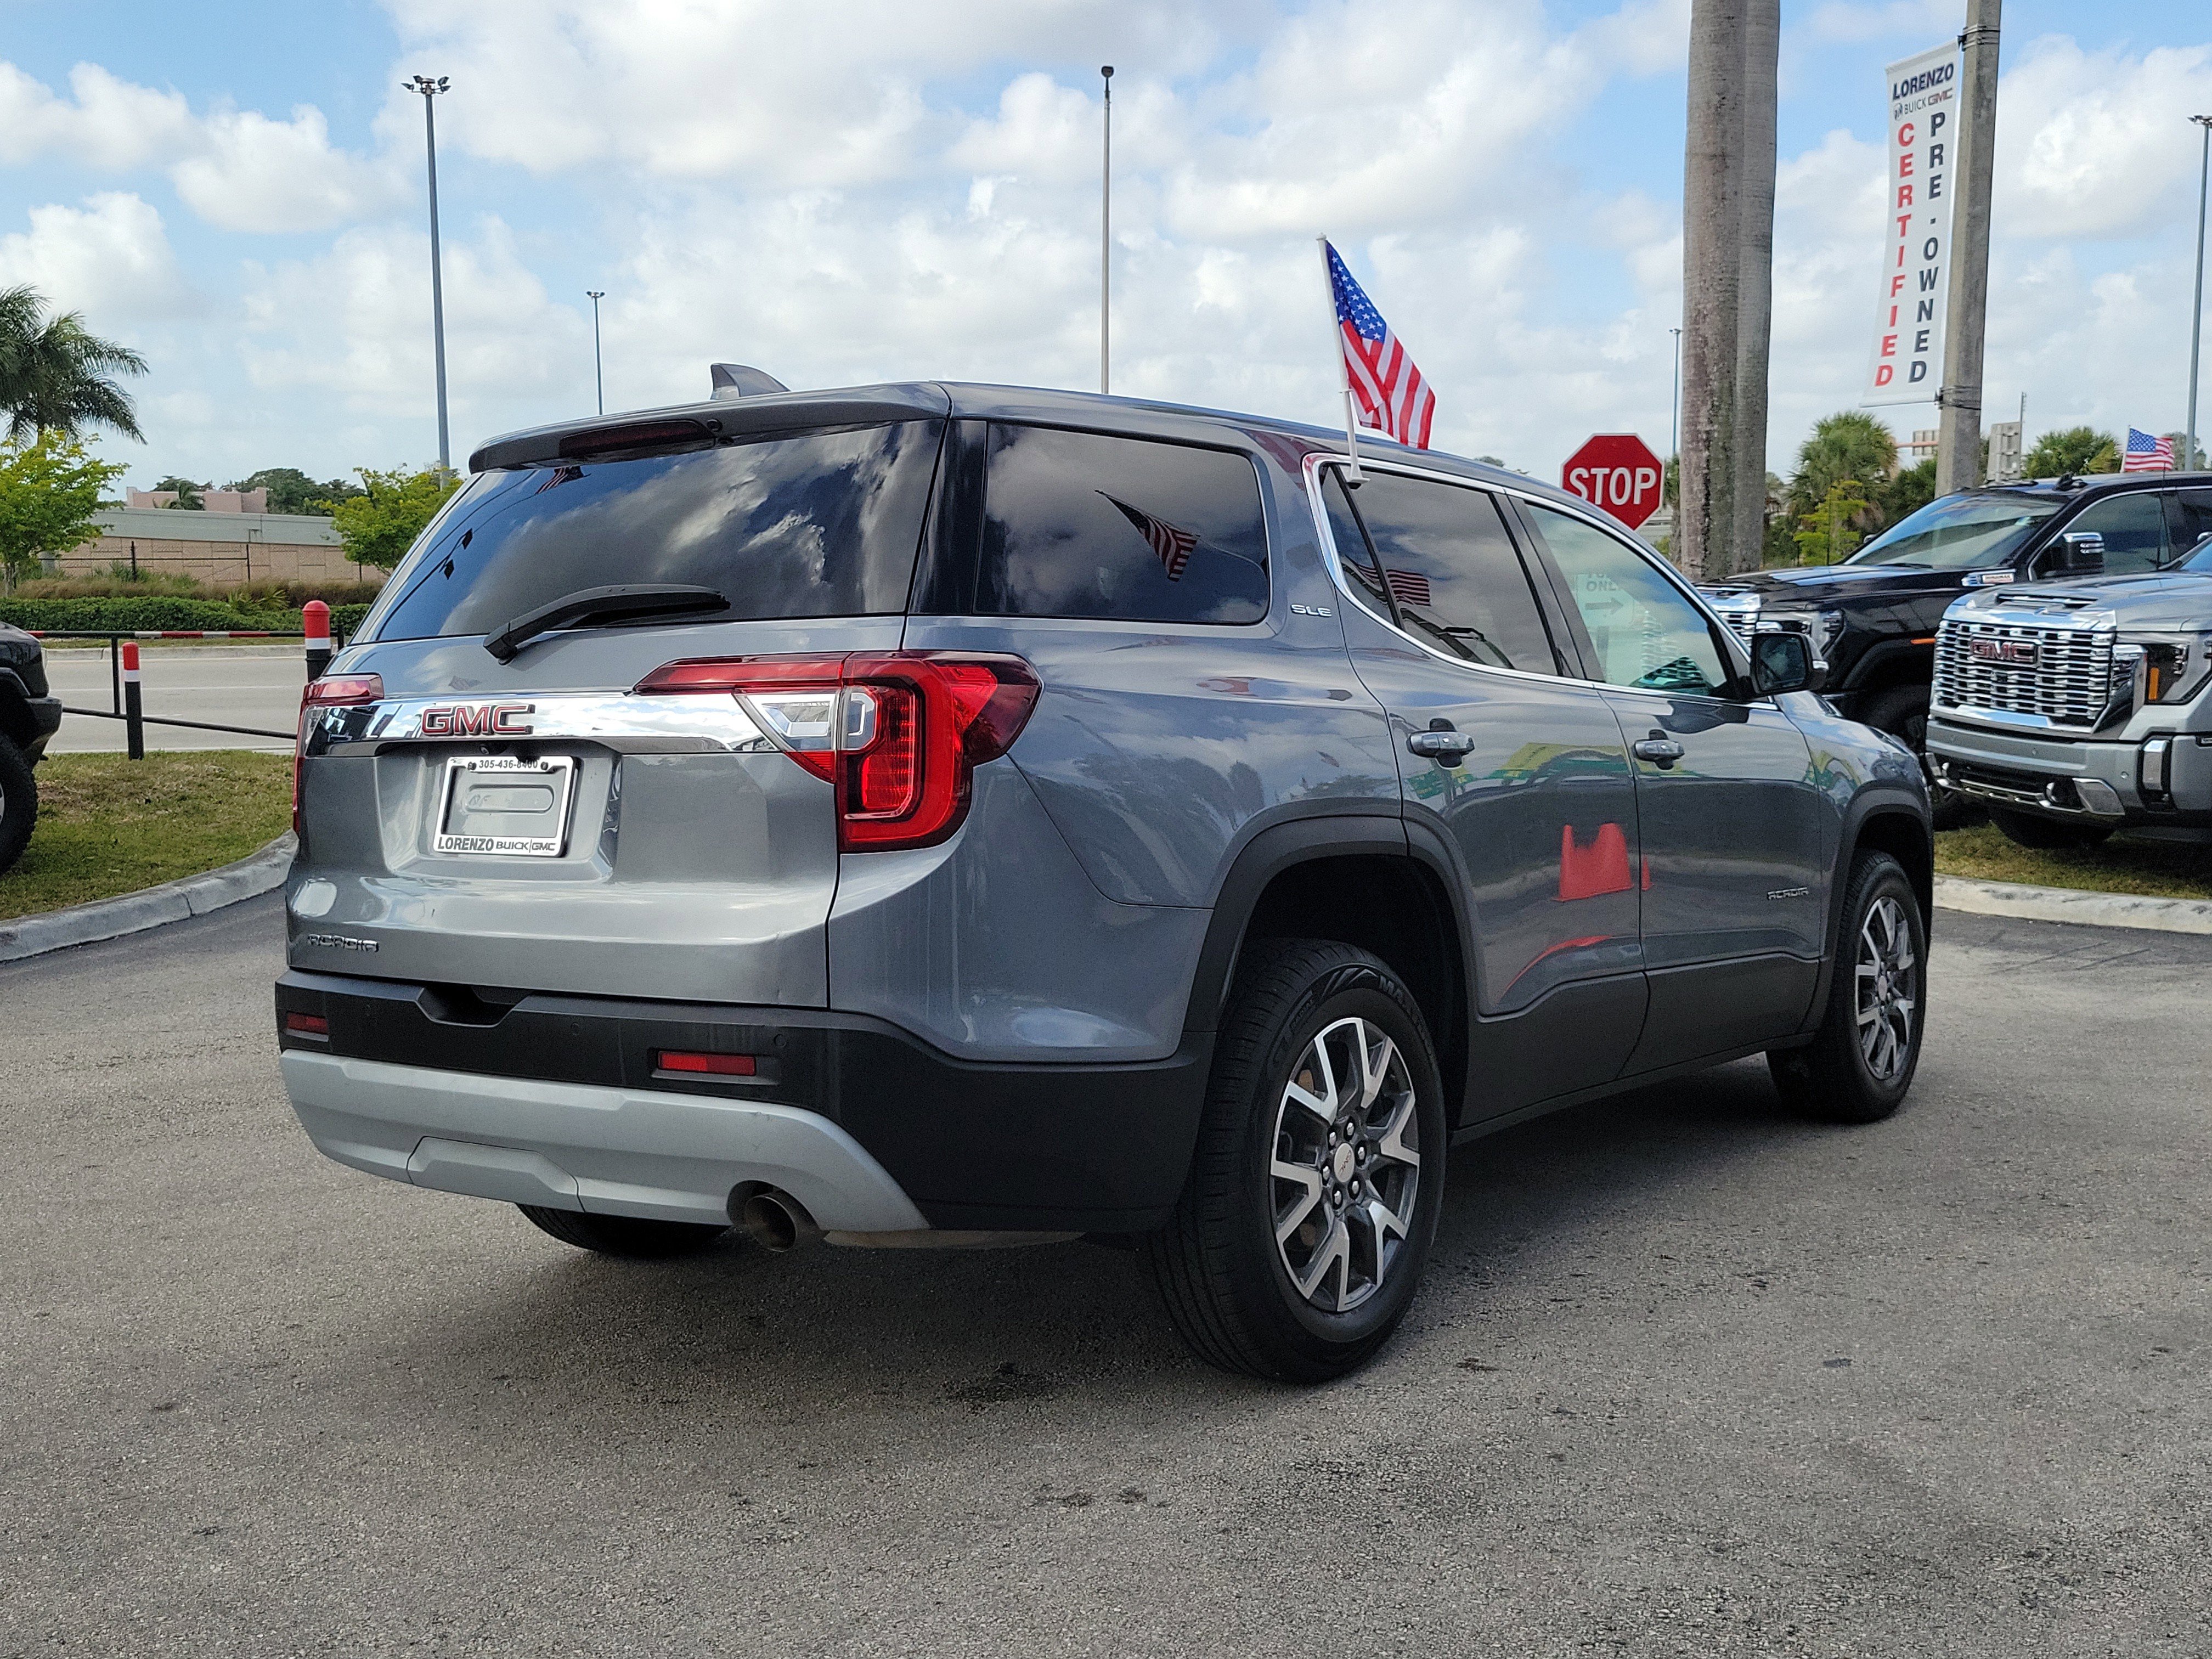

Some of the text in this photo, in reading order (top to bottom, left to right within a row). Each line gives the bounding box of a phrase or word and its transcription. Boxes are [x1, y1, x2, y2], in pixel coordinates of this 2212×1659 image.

[1893, 62, 1954, 100] LORENZO
[1904, 87, 1953, 115] BUICK GMC
[1875, 122, 1915, 387] CERTIFIED
[1570, 467, 1657, 505] STOP
[1290, 604, 1332, 617] SLE
[1971, 639, 2034, 663] GMC
[422, 704, 535, 736] GMC
[438, 837, 494, 851] LORENZO
[496, 841, 556, 851] BUICK GMC
[308, 934, 379, 952] ACADIA
